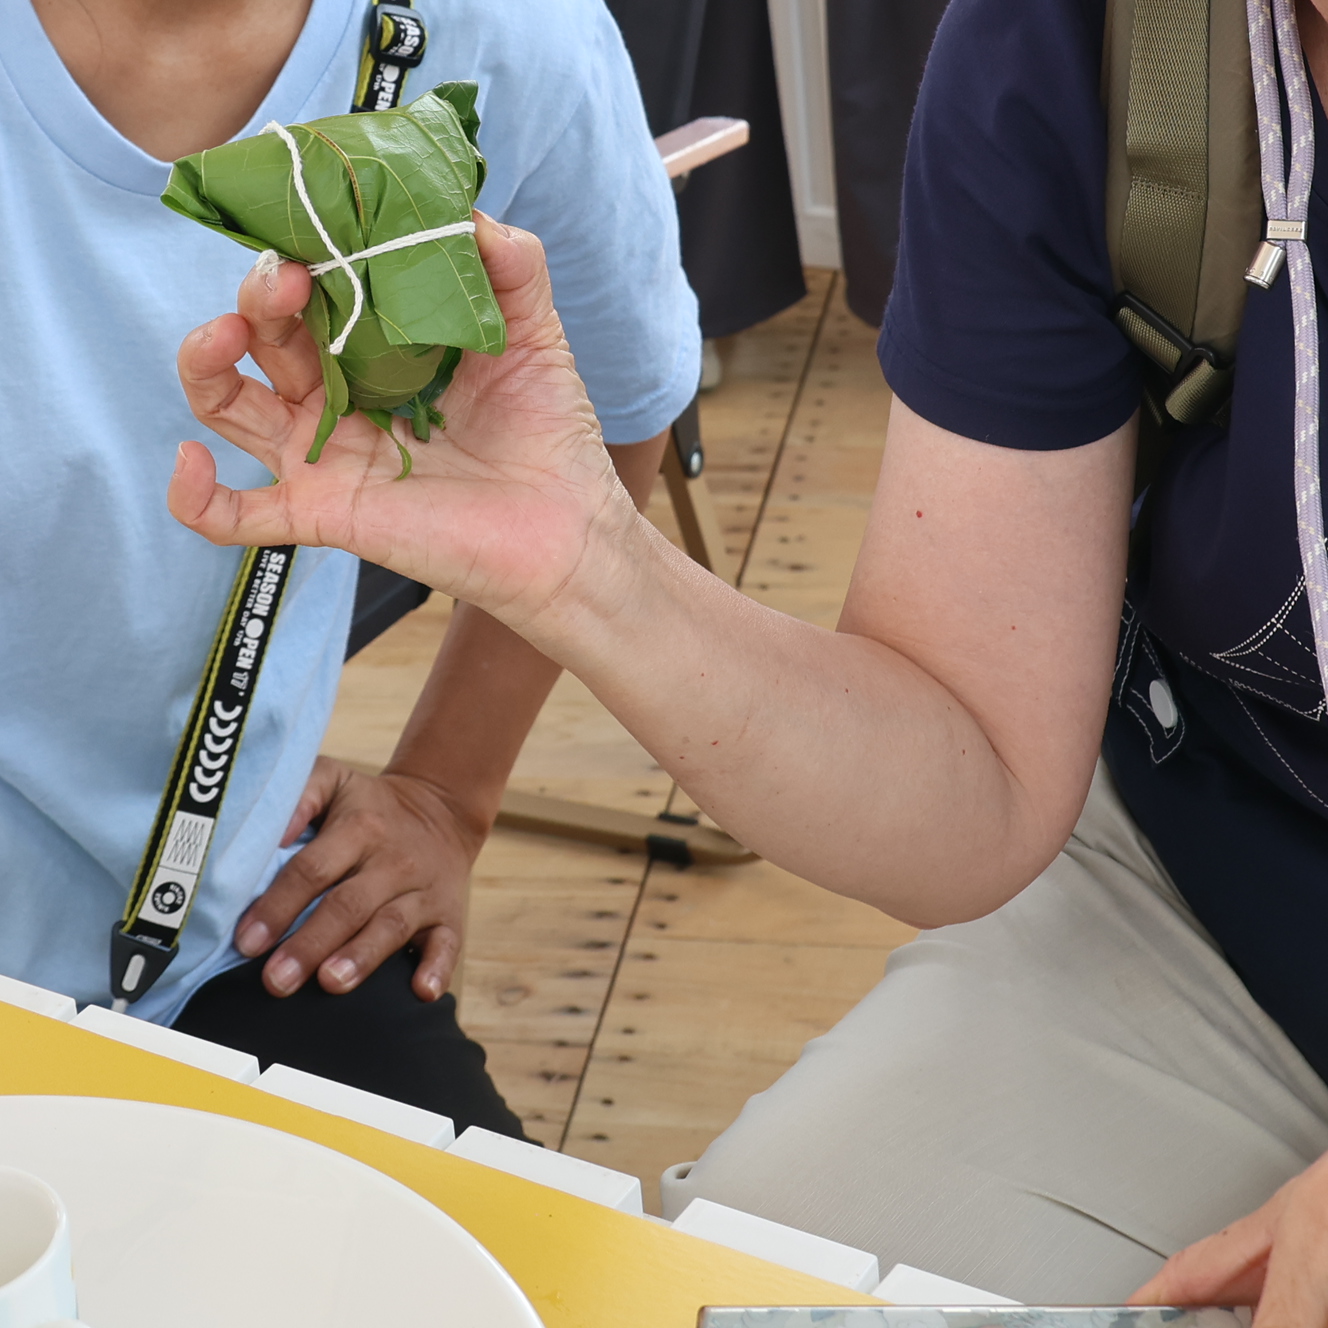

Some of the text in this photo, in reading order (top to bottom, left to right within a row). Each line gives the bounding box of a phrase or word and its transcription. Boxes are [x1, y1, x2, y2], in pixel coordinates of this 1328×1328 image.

[259, 549, 272, 569] LIVE
[245, 578, 262, 609] BETTER
[251, 552, 287, 617] SEASON
[239, 610, 251, 628] DAY
